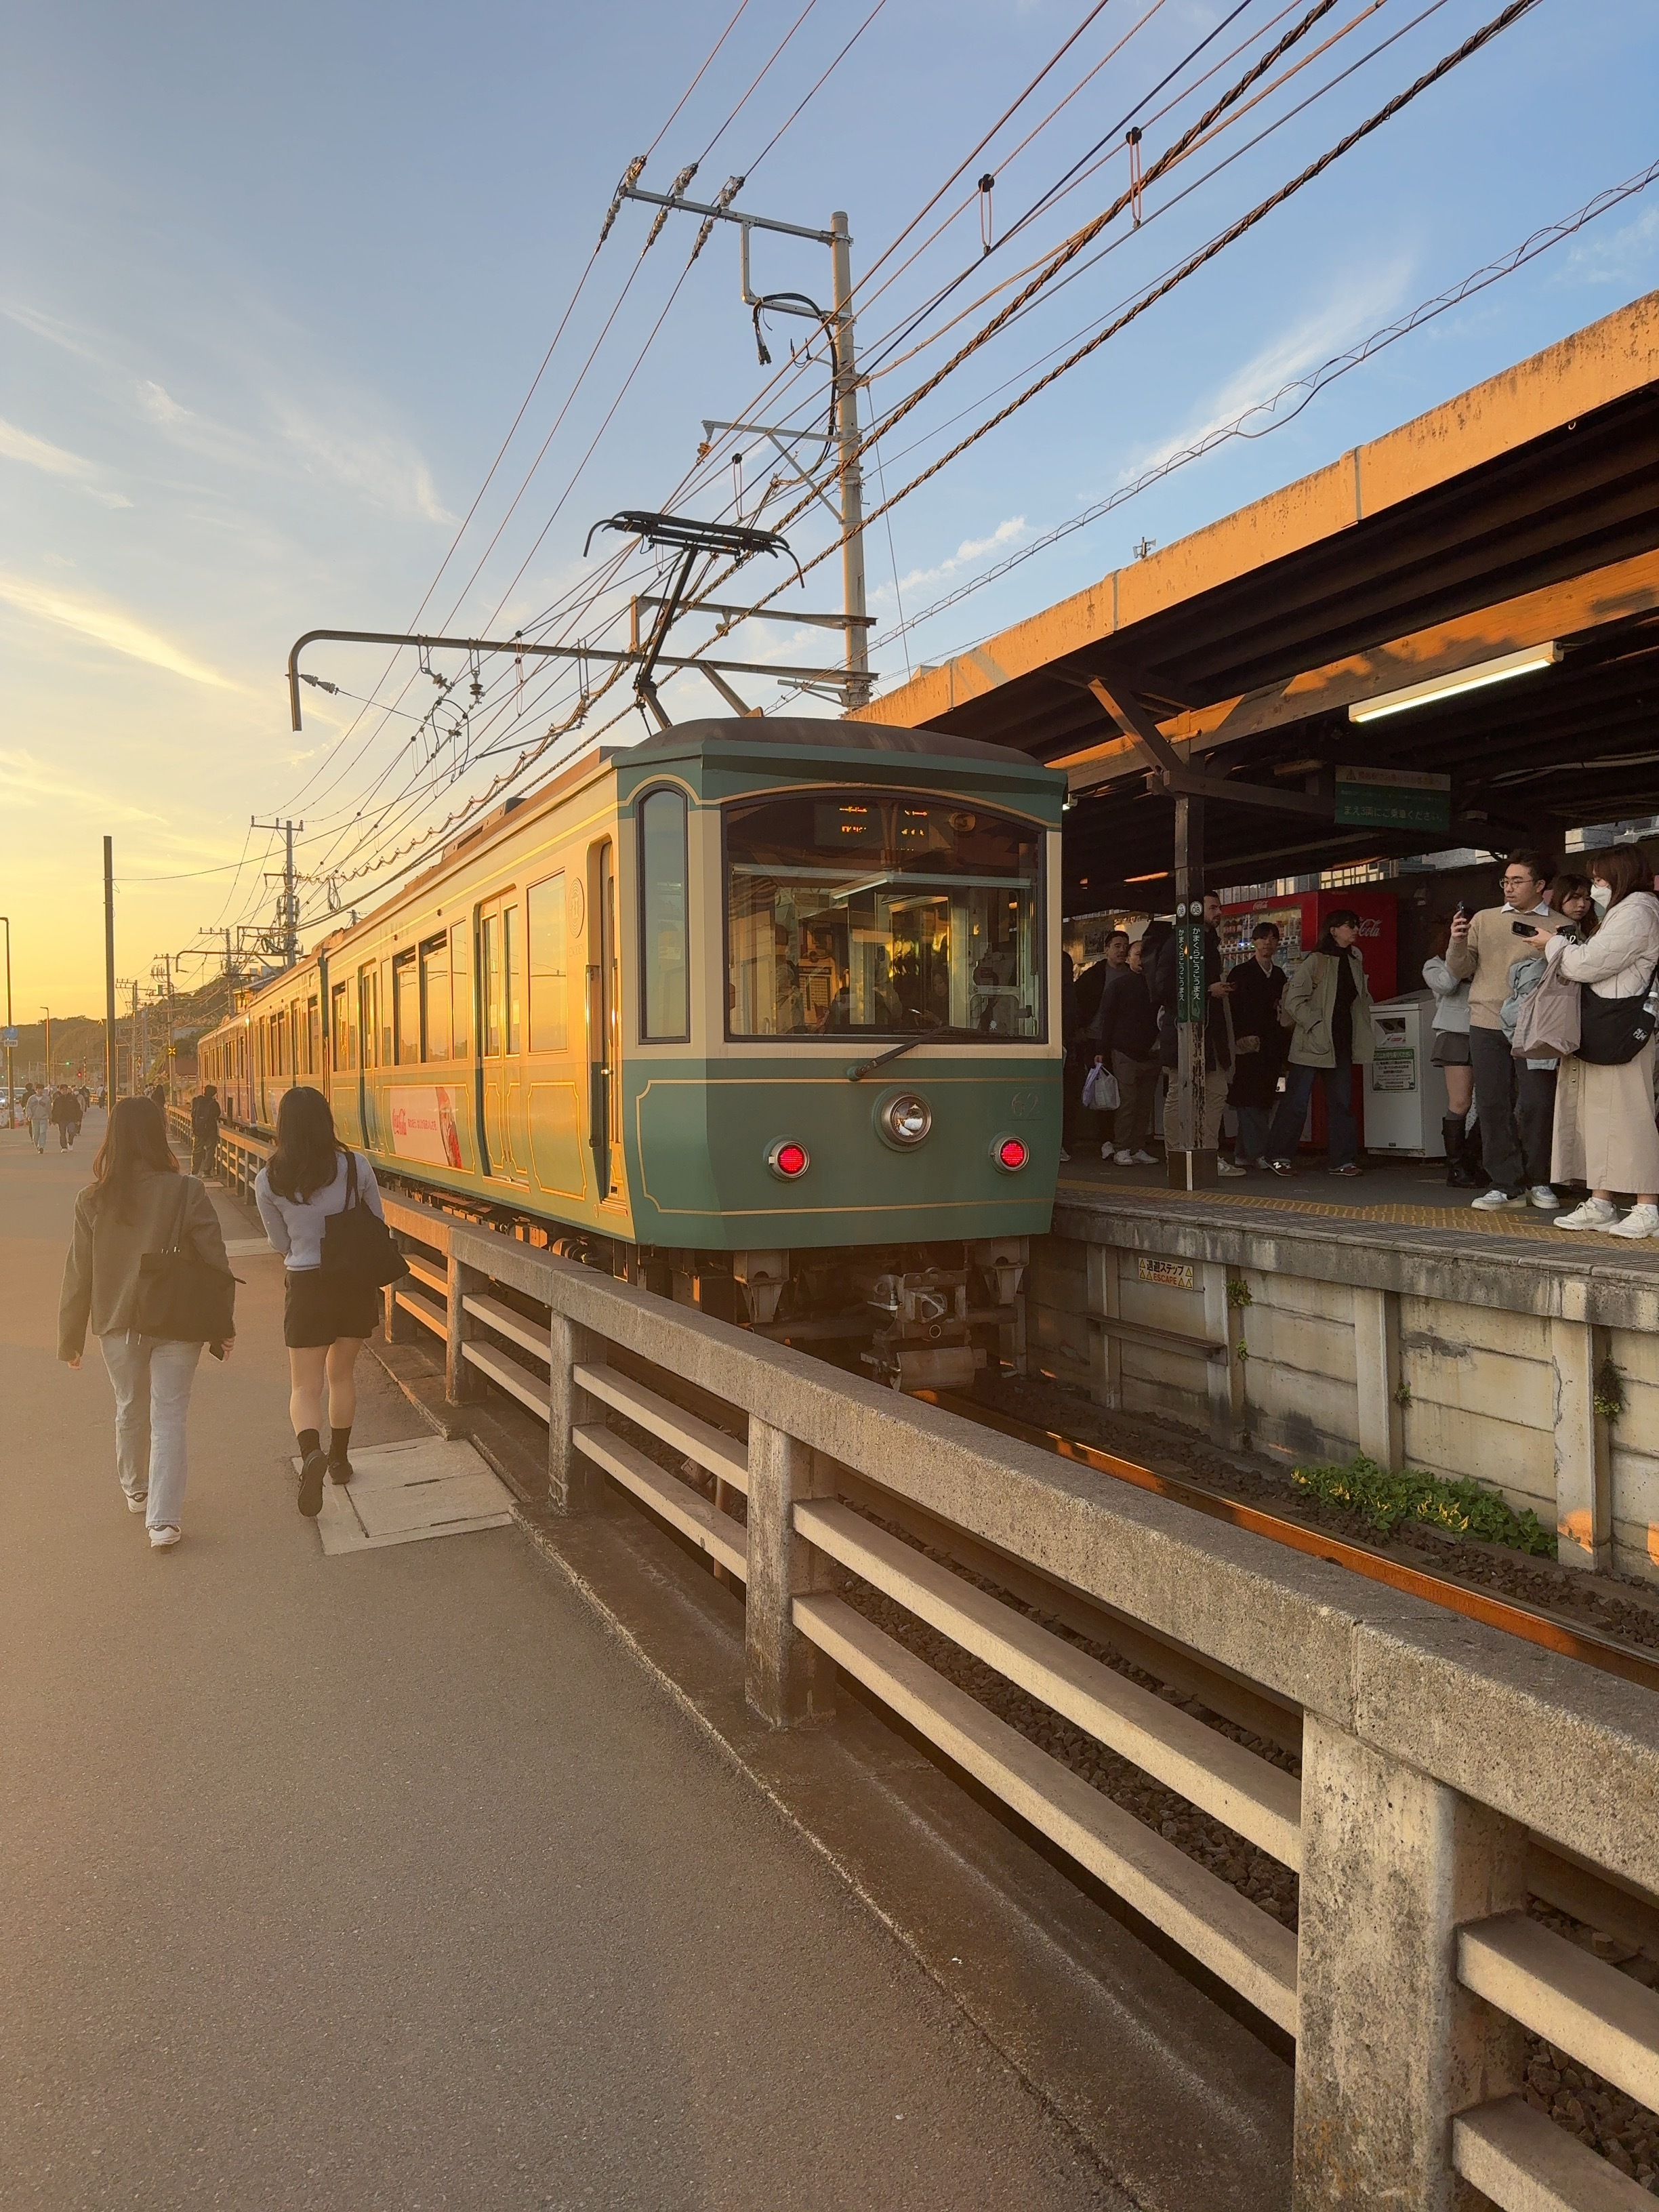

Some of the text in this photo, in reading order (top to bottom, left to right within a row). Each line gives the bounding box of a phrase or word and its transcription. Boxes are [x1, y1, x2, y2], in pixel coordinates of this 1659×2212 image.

[1192, 927, 1201, 1000] かまくらこうこうまえ
[1153, 1273, 1177, 1285] ESCAPE
